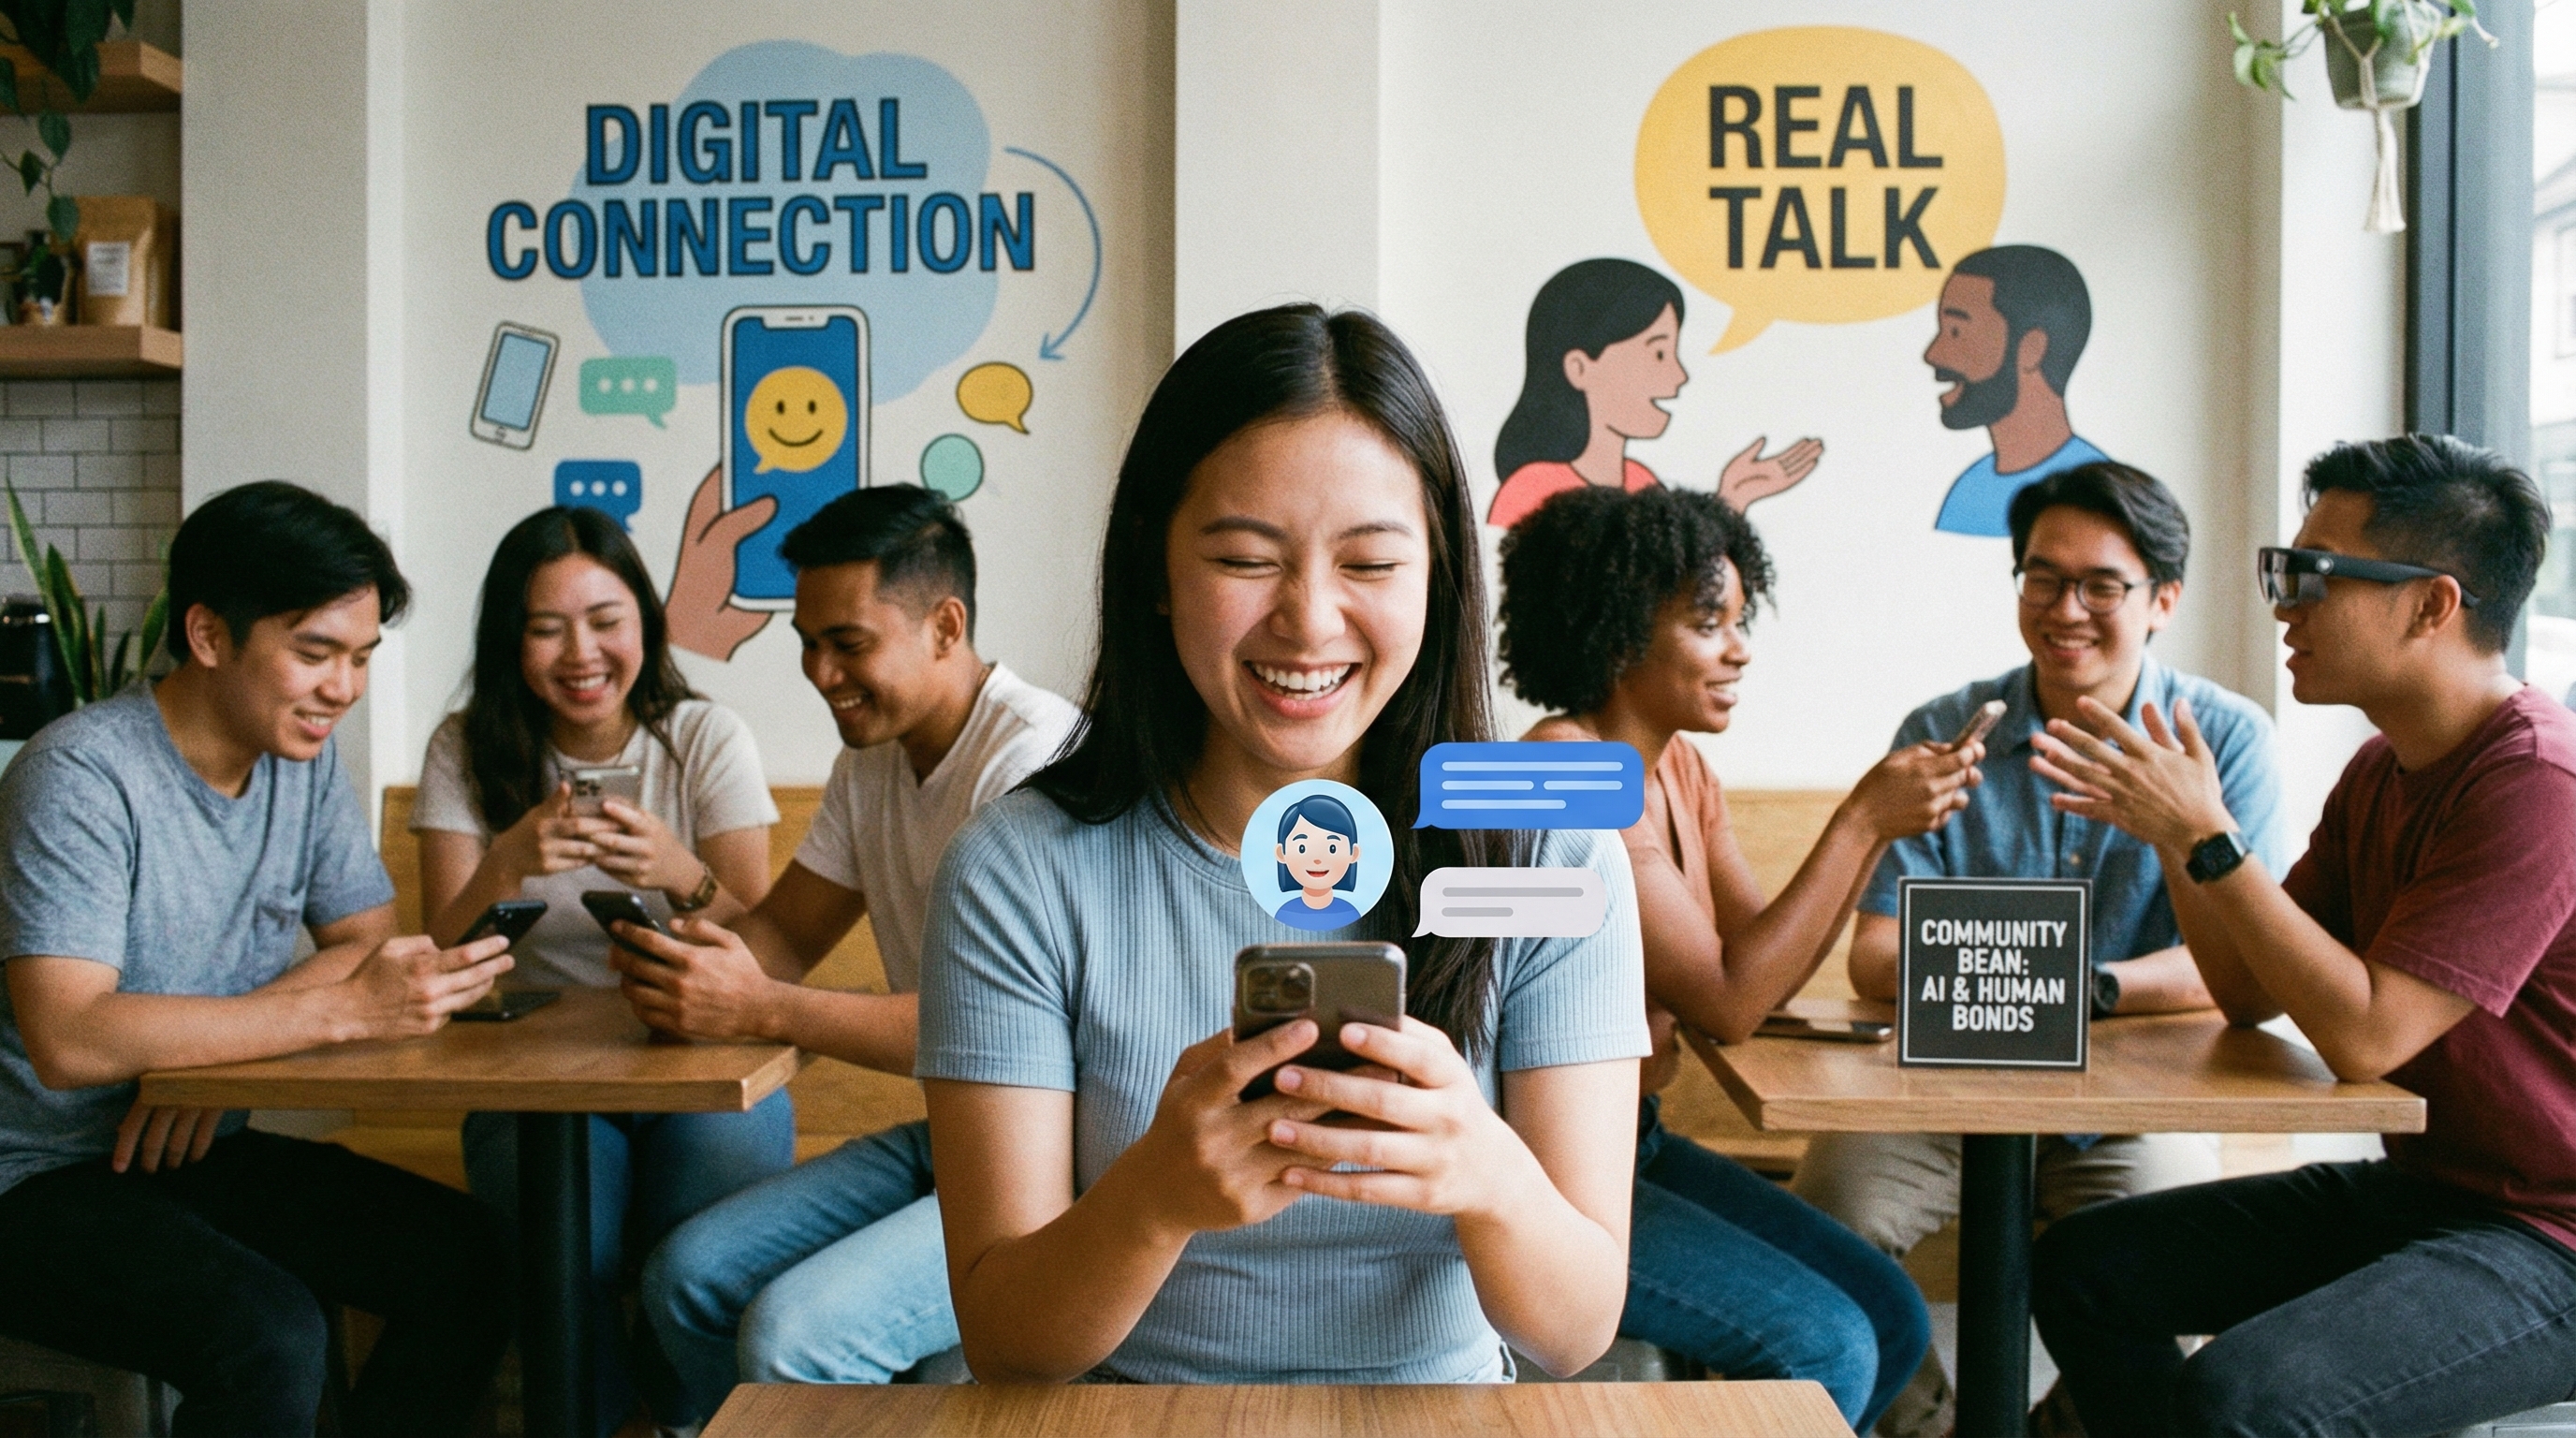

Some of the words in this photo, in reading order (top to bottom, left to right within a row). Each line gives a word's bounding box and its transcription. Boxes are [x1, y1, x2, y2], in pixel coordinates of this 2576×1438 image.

[586, 97, 929, 186] DIGITAL
[1708, 84, 1944, 169] REAL
[486, 192, 1034, 281] CONNECTION
[1708, 186, 1941, 270] TALK
[1921, 919, 2068, 947] COMMUNITY
[1957, 947, 2029, 976] BEAN:
[1921, 976, 1946, 1003] AI
[1952, 976, 1970, 1003] &
[1977, 976, 2066, 1005] HUMAN
[1952, 1005, 2035, 1033] BONDS
